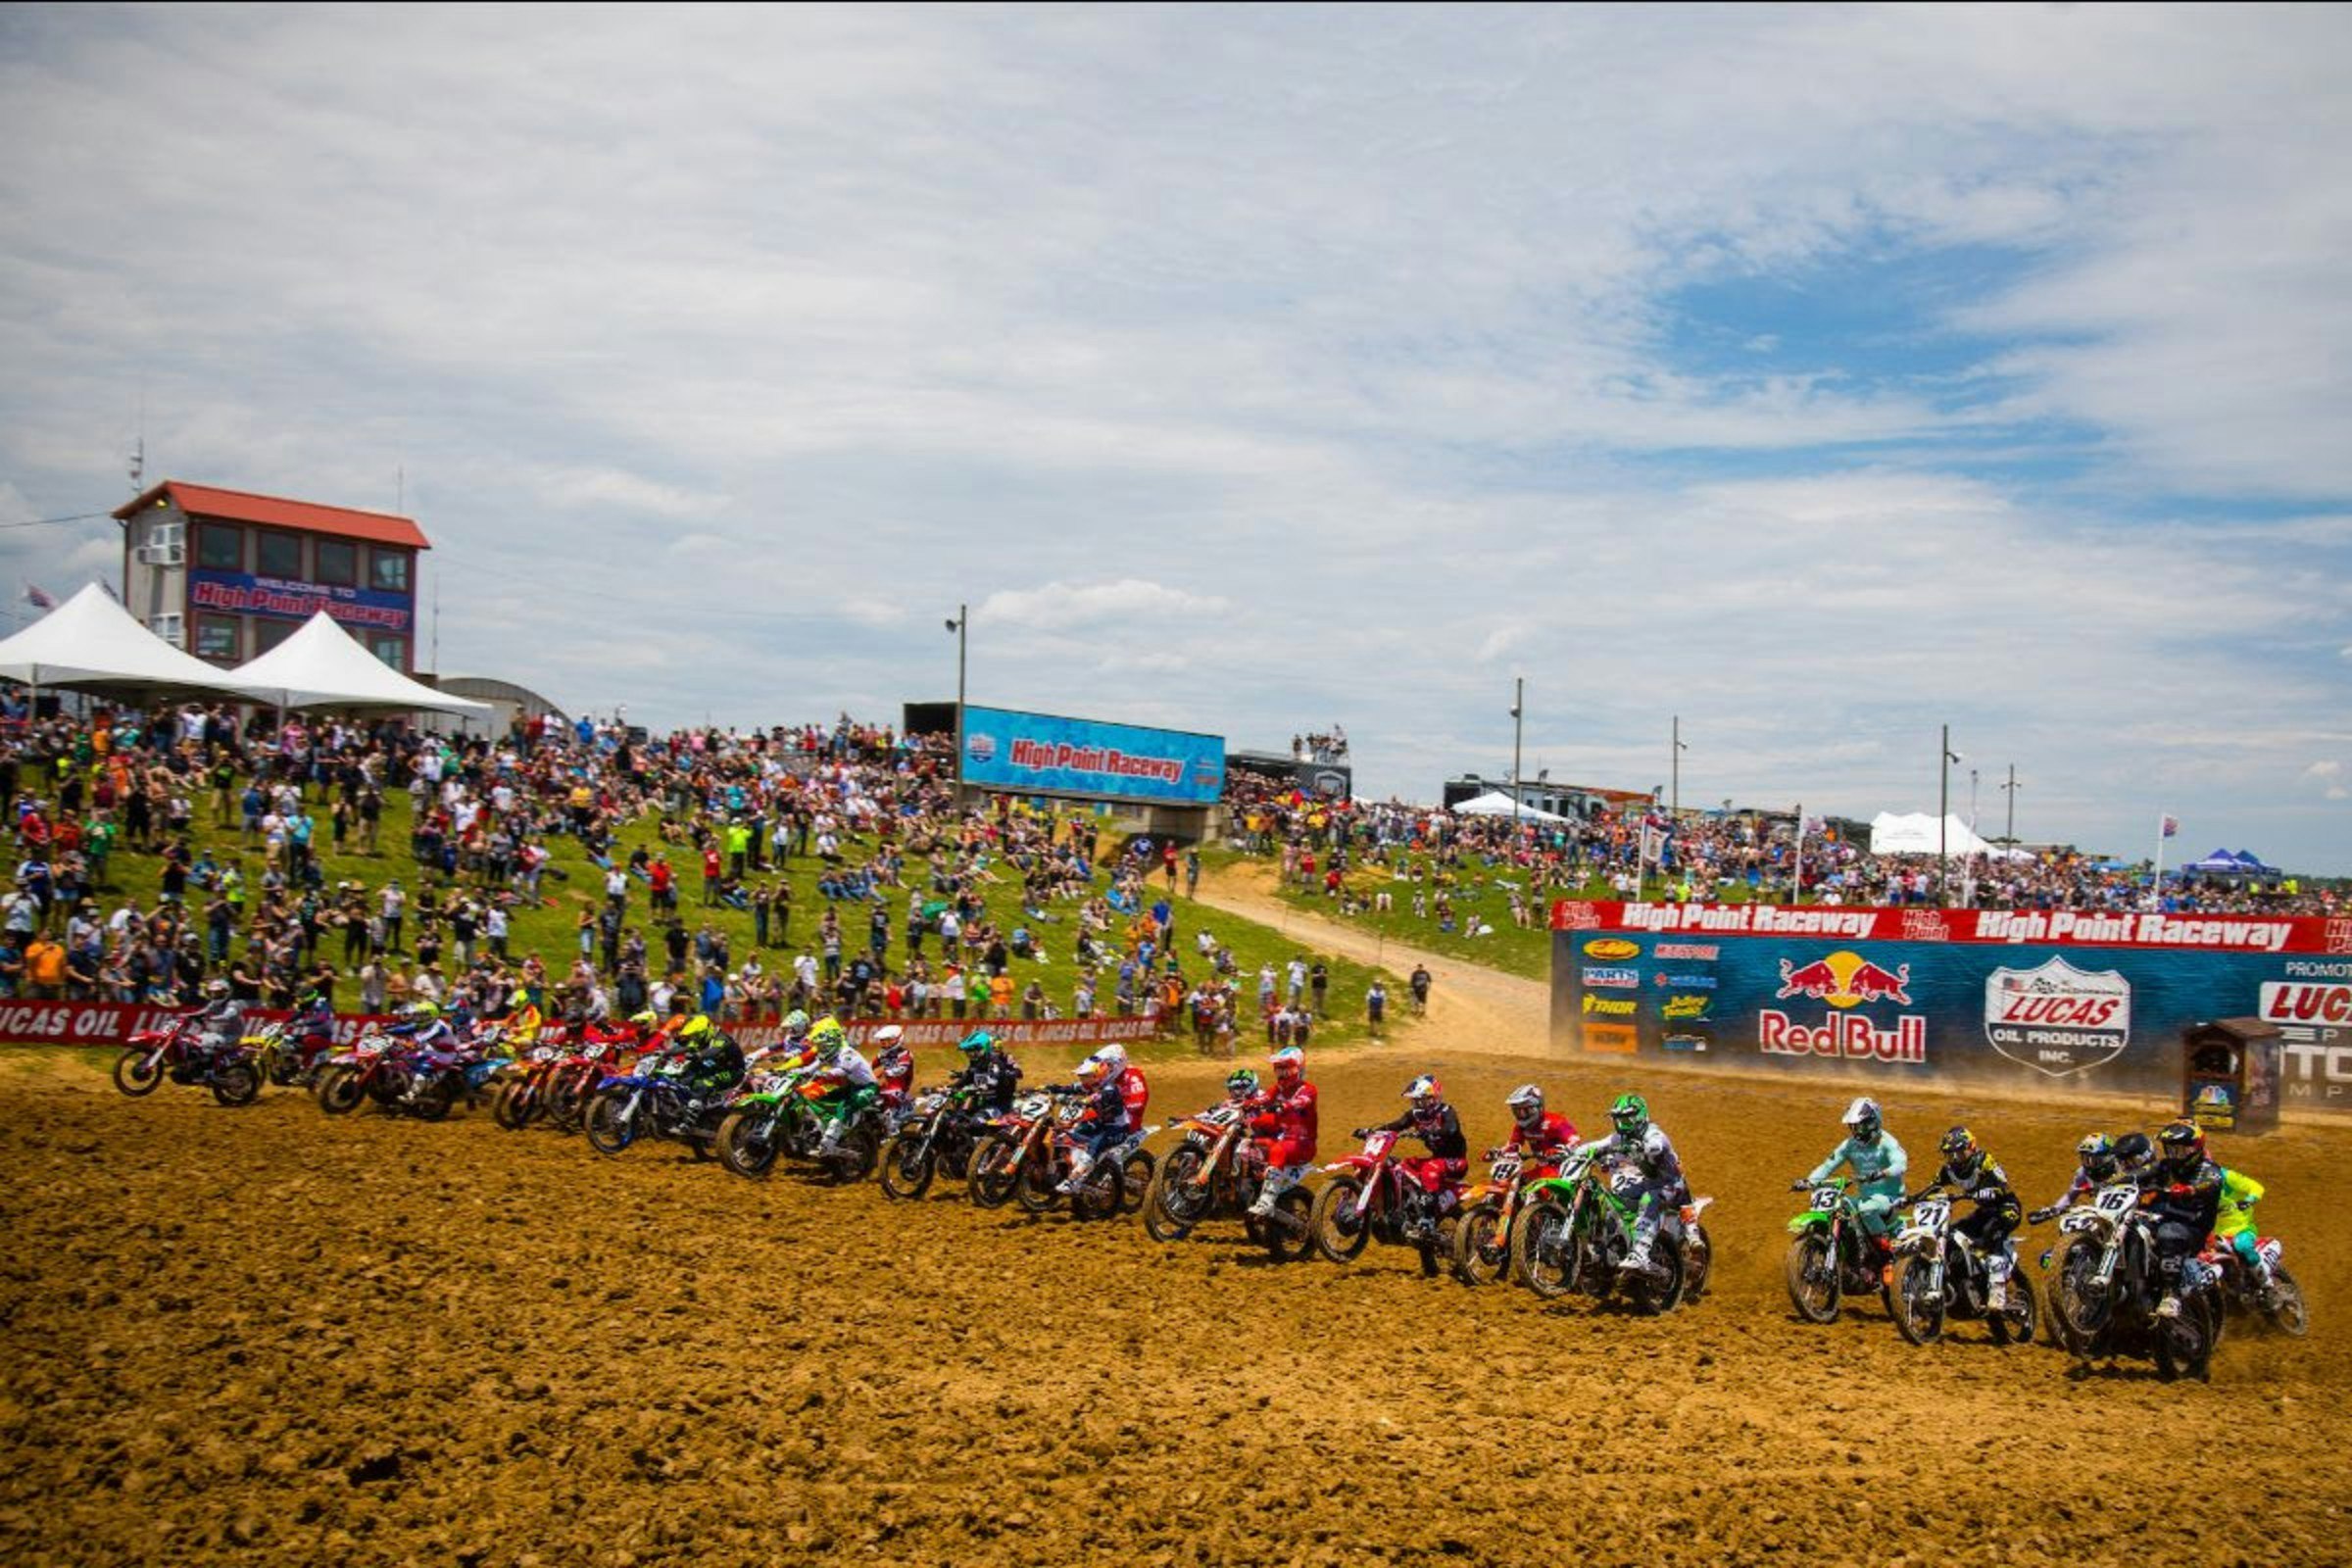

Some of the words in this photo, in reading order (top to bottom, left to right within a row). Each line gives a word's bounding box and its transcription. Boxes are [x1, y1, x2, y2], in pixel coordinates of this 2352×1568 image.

[193, 581, 244, 610] High
[251, 588, 309, 616] Point
[1010, 738, 1054, 772] High
[1057, 743, 1103, 772] Point
[1106, 748, 1185, 784] Raceway
[1622, 902, 1680, 931] High
[1681, 904, 1751, 930] Point
[1752, 905, 1878, 938] Raceway
[1901, 908, 1940, 927] High
[1903, 924, 1949, 941] Point
[1976, 910, 2047, 943] High
[2048, 912, 2135, 942] Point
[2136, 914, 2292, 952] Raceway
[1585, 968, 1639, 980] PARTS
[1594, 1001, 1637, 1014] THOR
[2002, 996, 2120, 1026] LUCAS
[2269, 986, 2352, 1021] LUC
[74, 1009, 121, 1037] OIL
[1101, 1022, 1138, 1040] LUCAS
[1760, 1009, 1840, 1056] Red
[1843, 1014, 1926, 1063] Bull
[1993, 1029, 2023, 1043] OIL
[2027, 1030, 2120, 1048] PRODUCTS
[2038, 1051, 2075, 1063] INC.
[1021, 1102, 1044, 1116] 2
[2099, 1193, 2129, 1210] 16
[1918, 1206, 1943, 1227] 21
